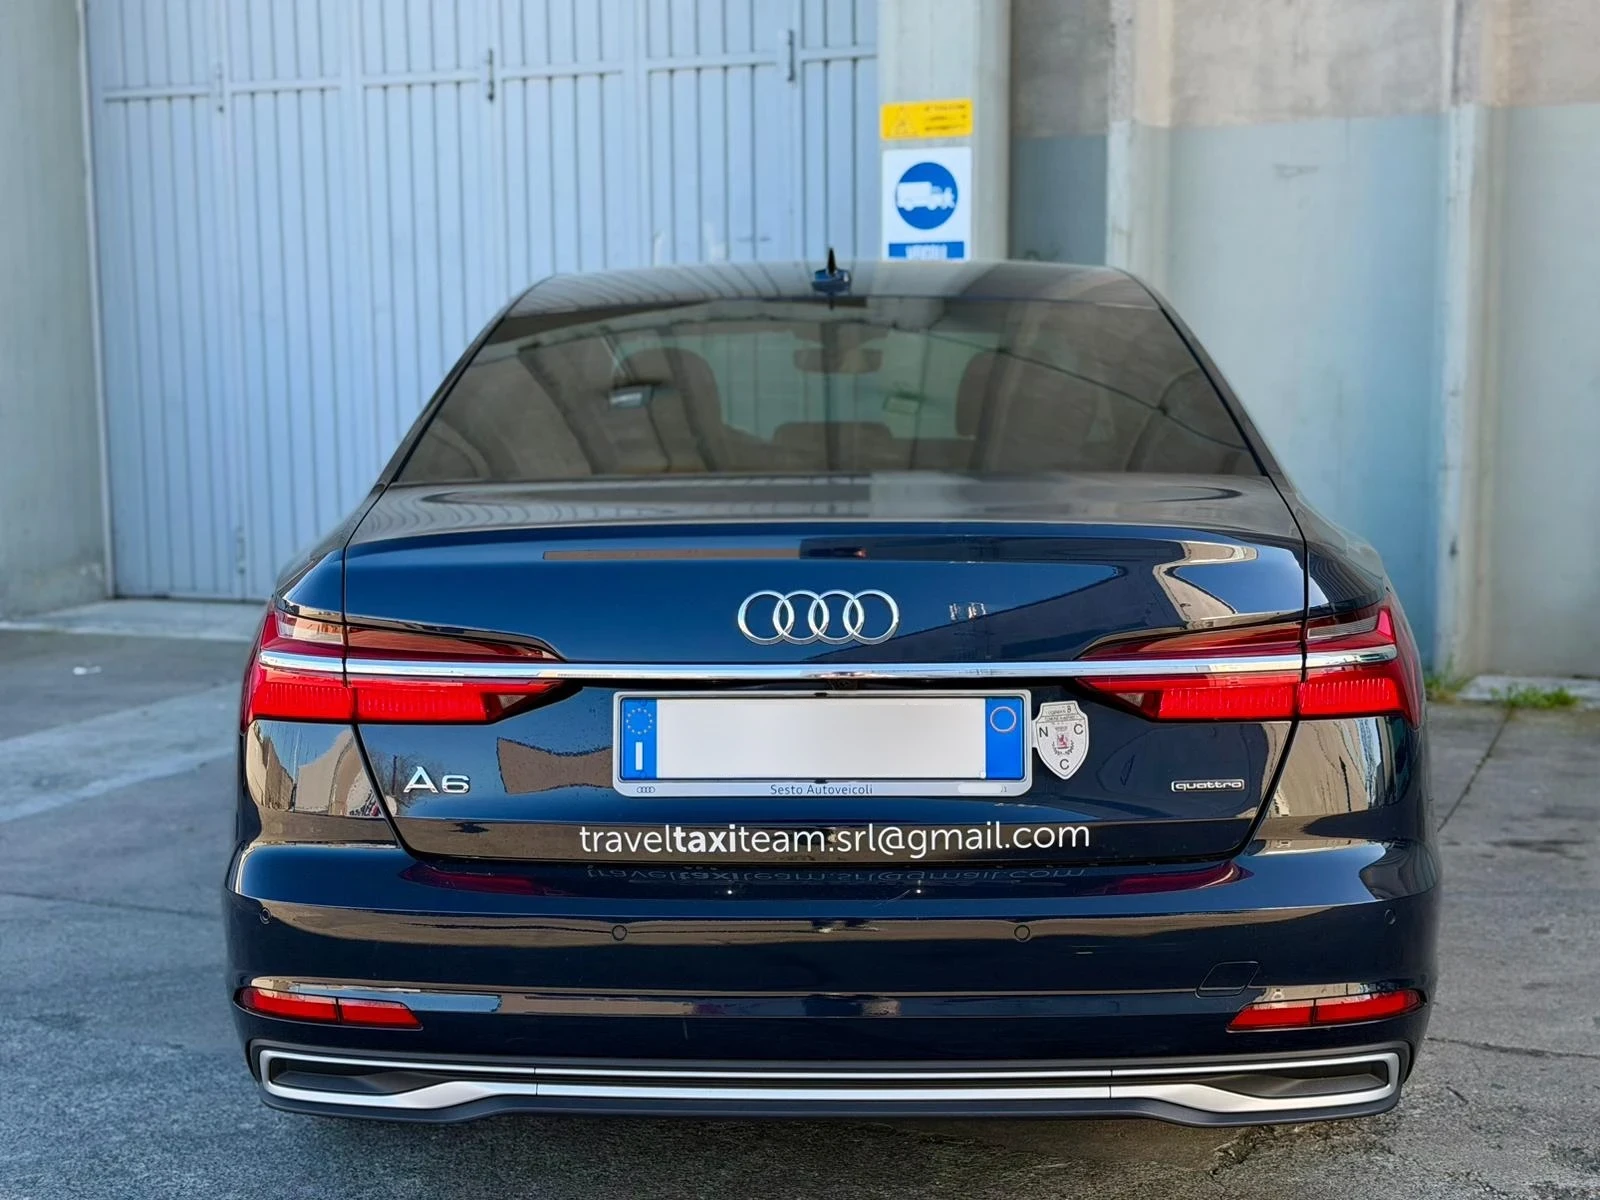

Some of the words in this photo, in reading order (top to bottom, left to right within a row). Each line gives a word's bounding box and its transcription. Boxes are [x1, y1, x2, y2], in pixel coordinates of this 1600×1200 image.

[1039, 726, 1049, 738] N
[1073, 724, 1083, 735] C
[1059, 759, 1069, 770] C
[403, 766, 470, 793] A6
[770, 784, 803, 795] Sesto
[806, 784, 873, 795] Autoveicoli
[1175, 782, 1242, 791] quattro
[579, 821, 1092, 858] traveltaxiteam.srl@gmail.com
